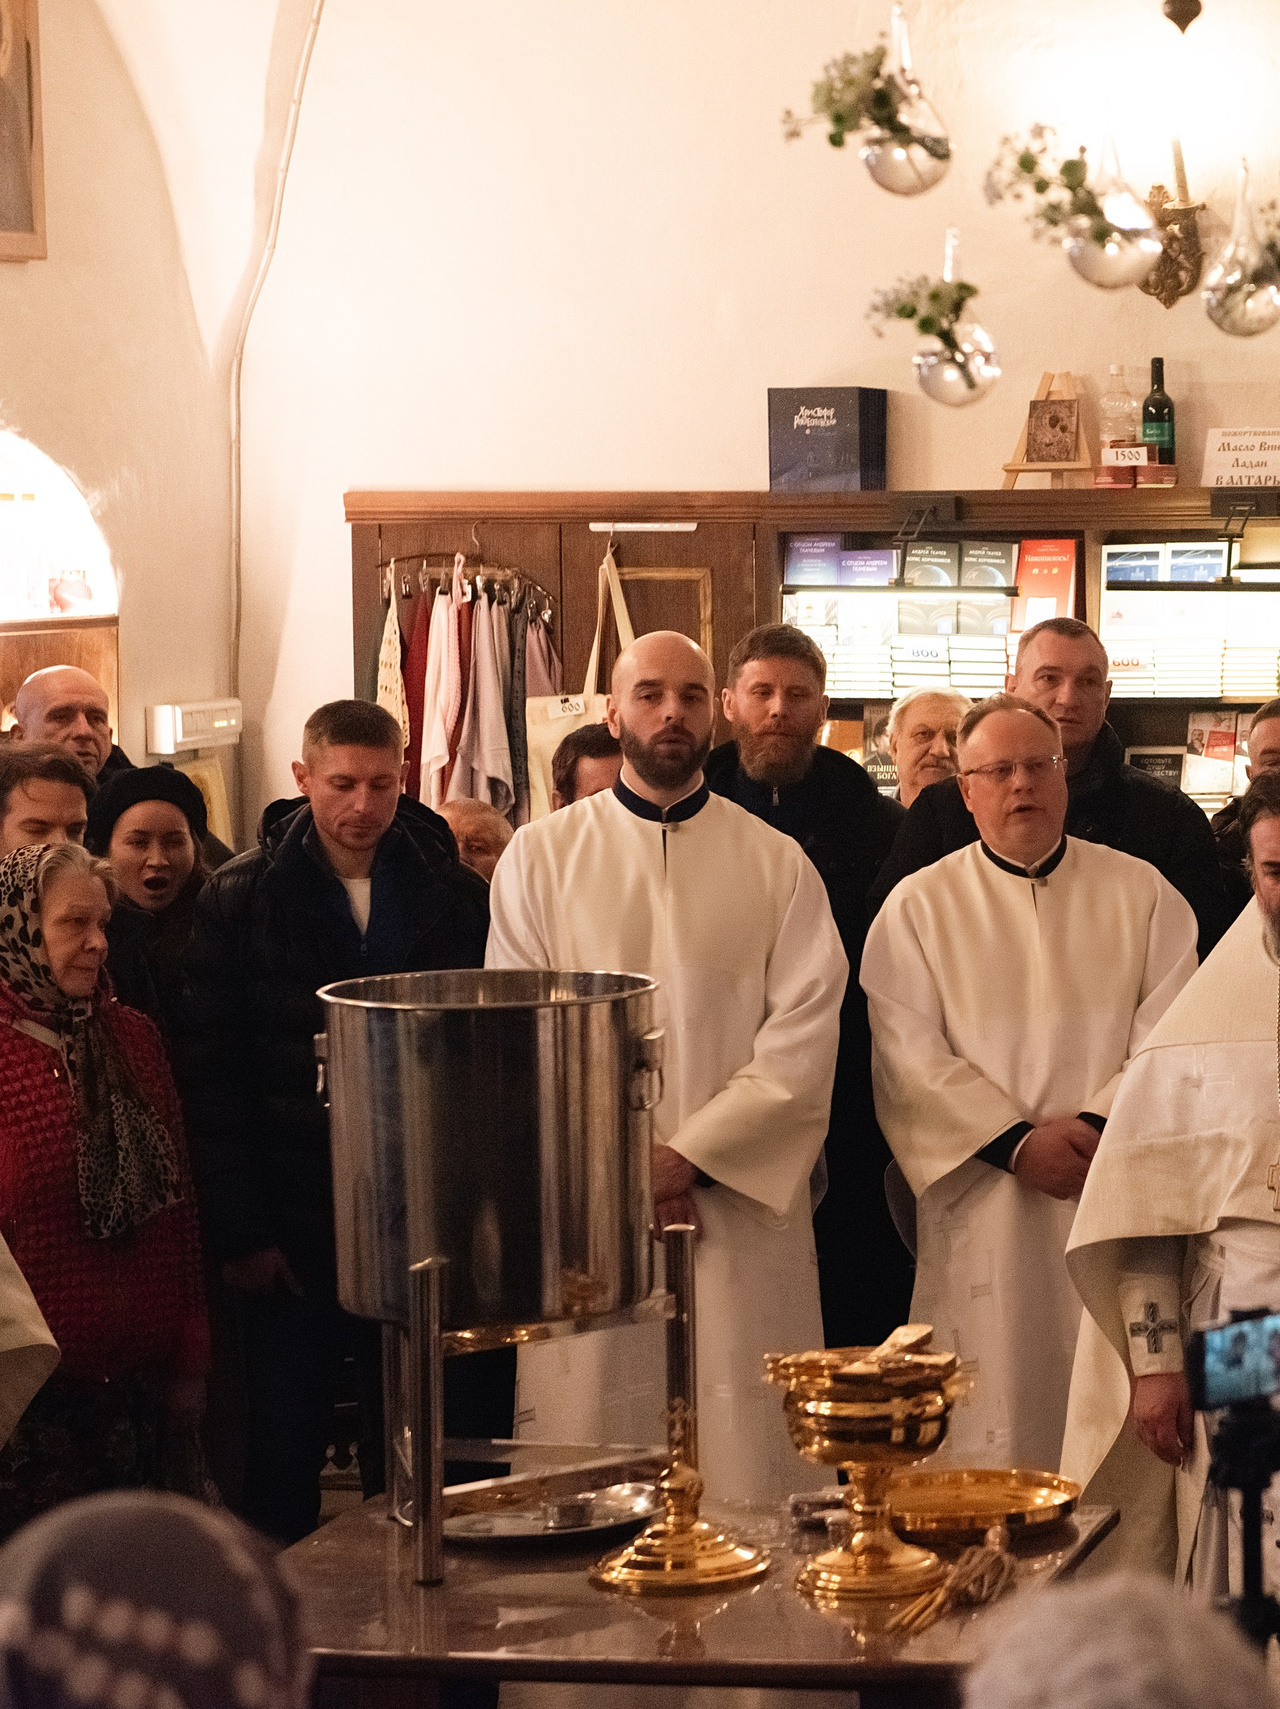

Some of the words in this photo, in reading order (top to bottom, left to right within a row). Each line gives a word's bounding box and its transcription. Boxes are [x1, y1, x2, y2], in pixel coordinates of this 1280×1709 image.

[1217, 441, 1256, 452] Масло
[1115, 450, 1141, 461] 1500
[1231, 457, 1267, 469] Ладан
[1225, 475, 1280, 485] АЛТАРЬ
[561, 702, 581, 713] 600
[876, 772, 897, 780] БОГА
